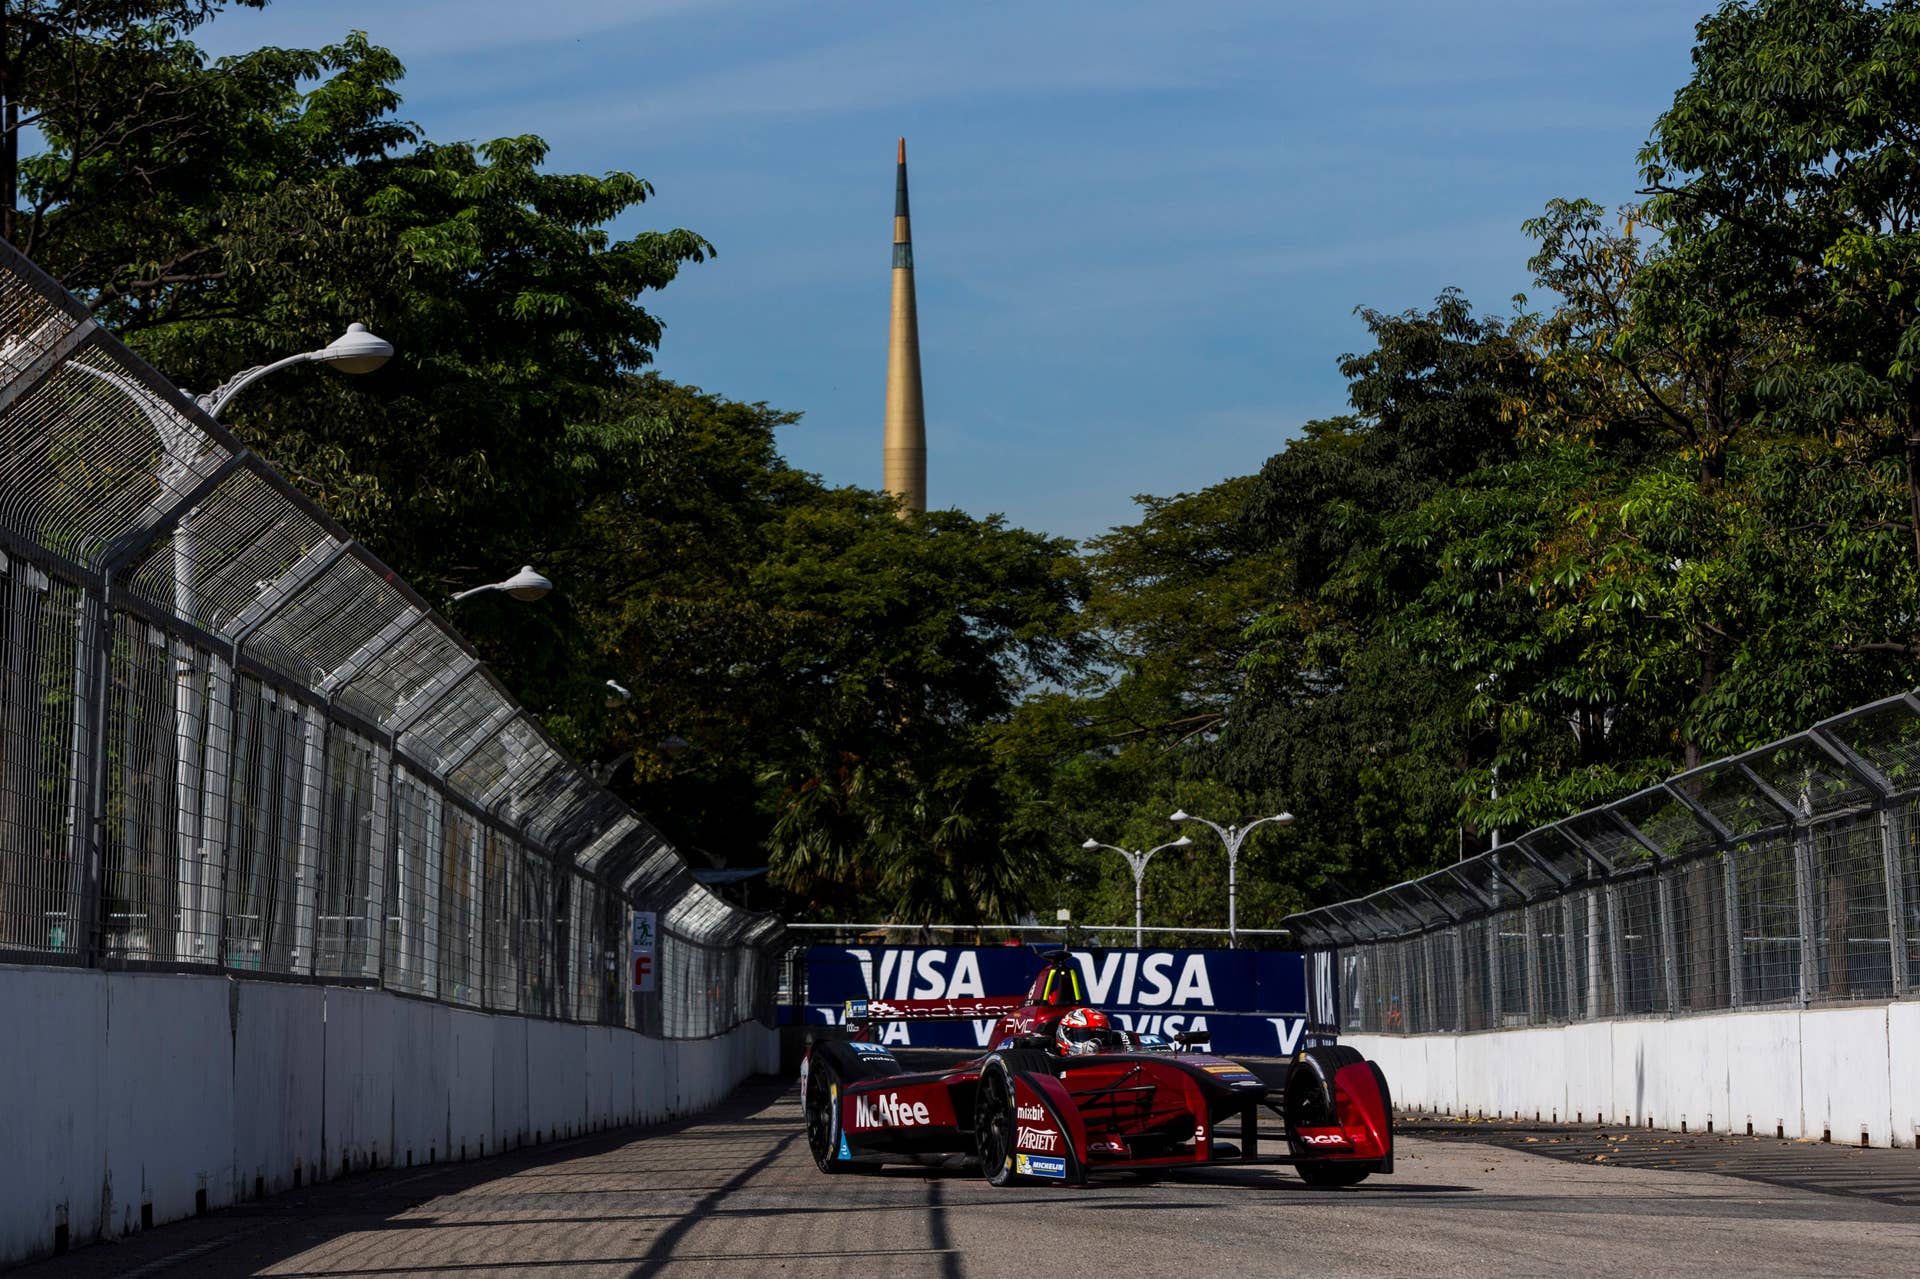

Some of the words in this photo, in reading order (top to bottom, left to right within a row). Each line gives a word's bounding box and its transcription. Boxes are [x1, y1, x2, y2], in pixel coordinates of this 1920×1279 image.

[635, 957, 652, 985] F
[846, 950, 985, 1000] VISA
[1070, 952, 1214, 1006] VISA
[1004, 1018, 1035, 1034] PMC
[856, 1092, 930, 1128] McAfee
[1017, 1103, 1045, 1121] mixbit
[1017, 1126, 1058, 1151] VARIETY
[1032, 1161, 1064, 1171] MICHELIN
